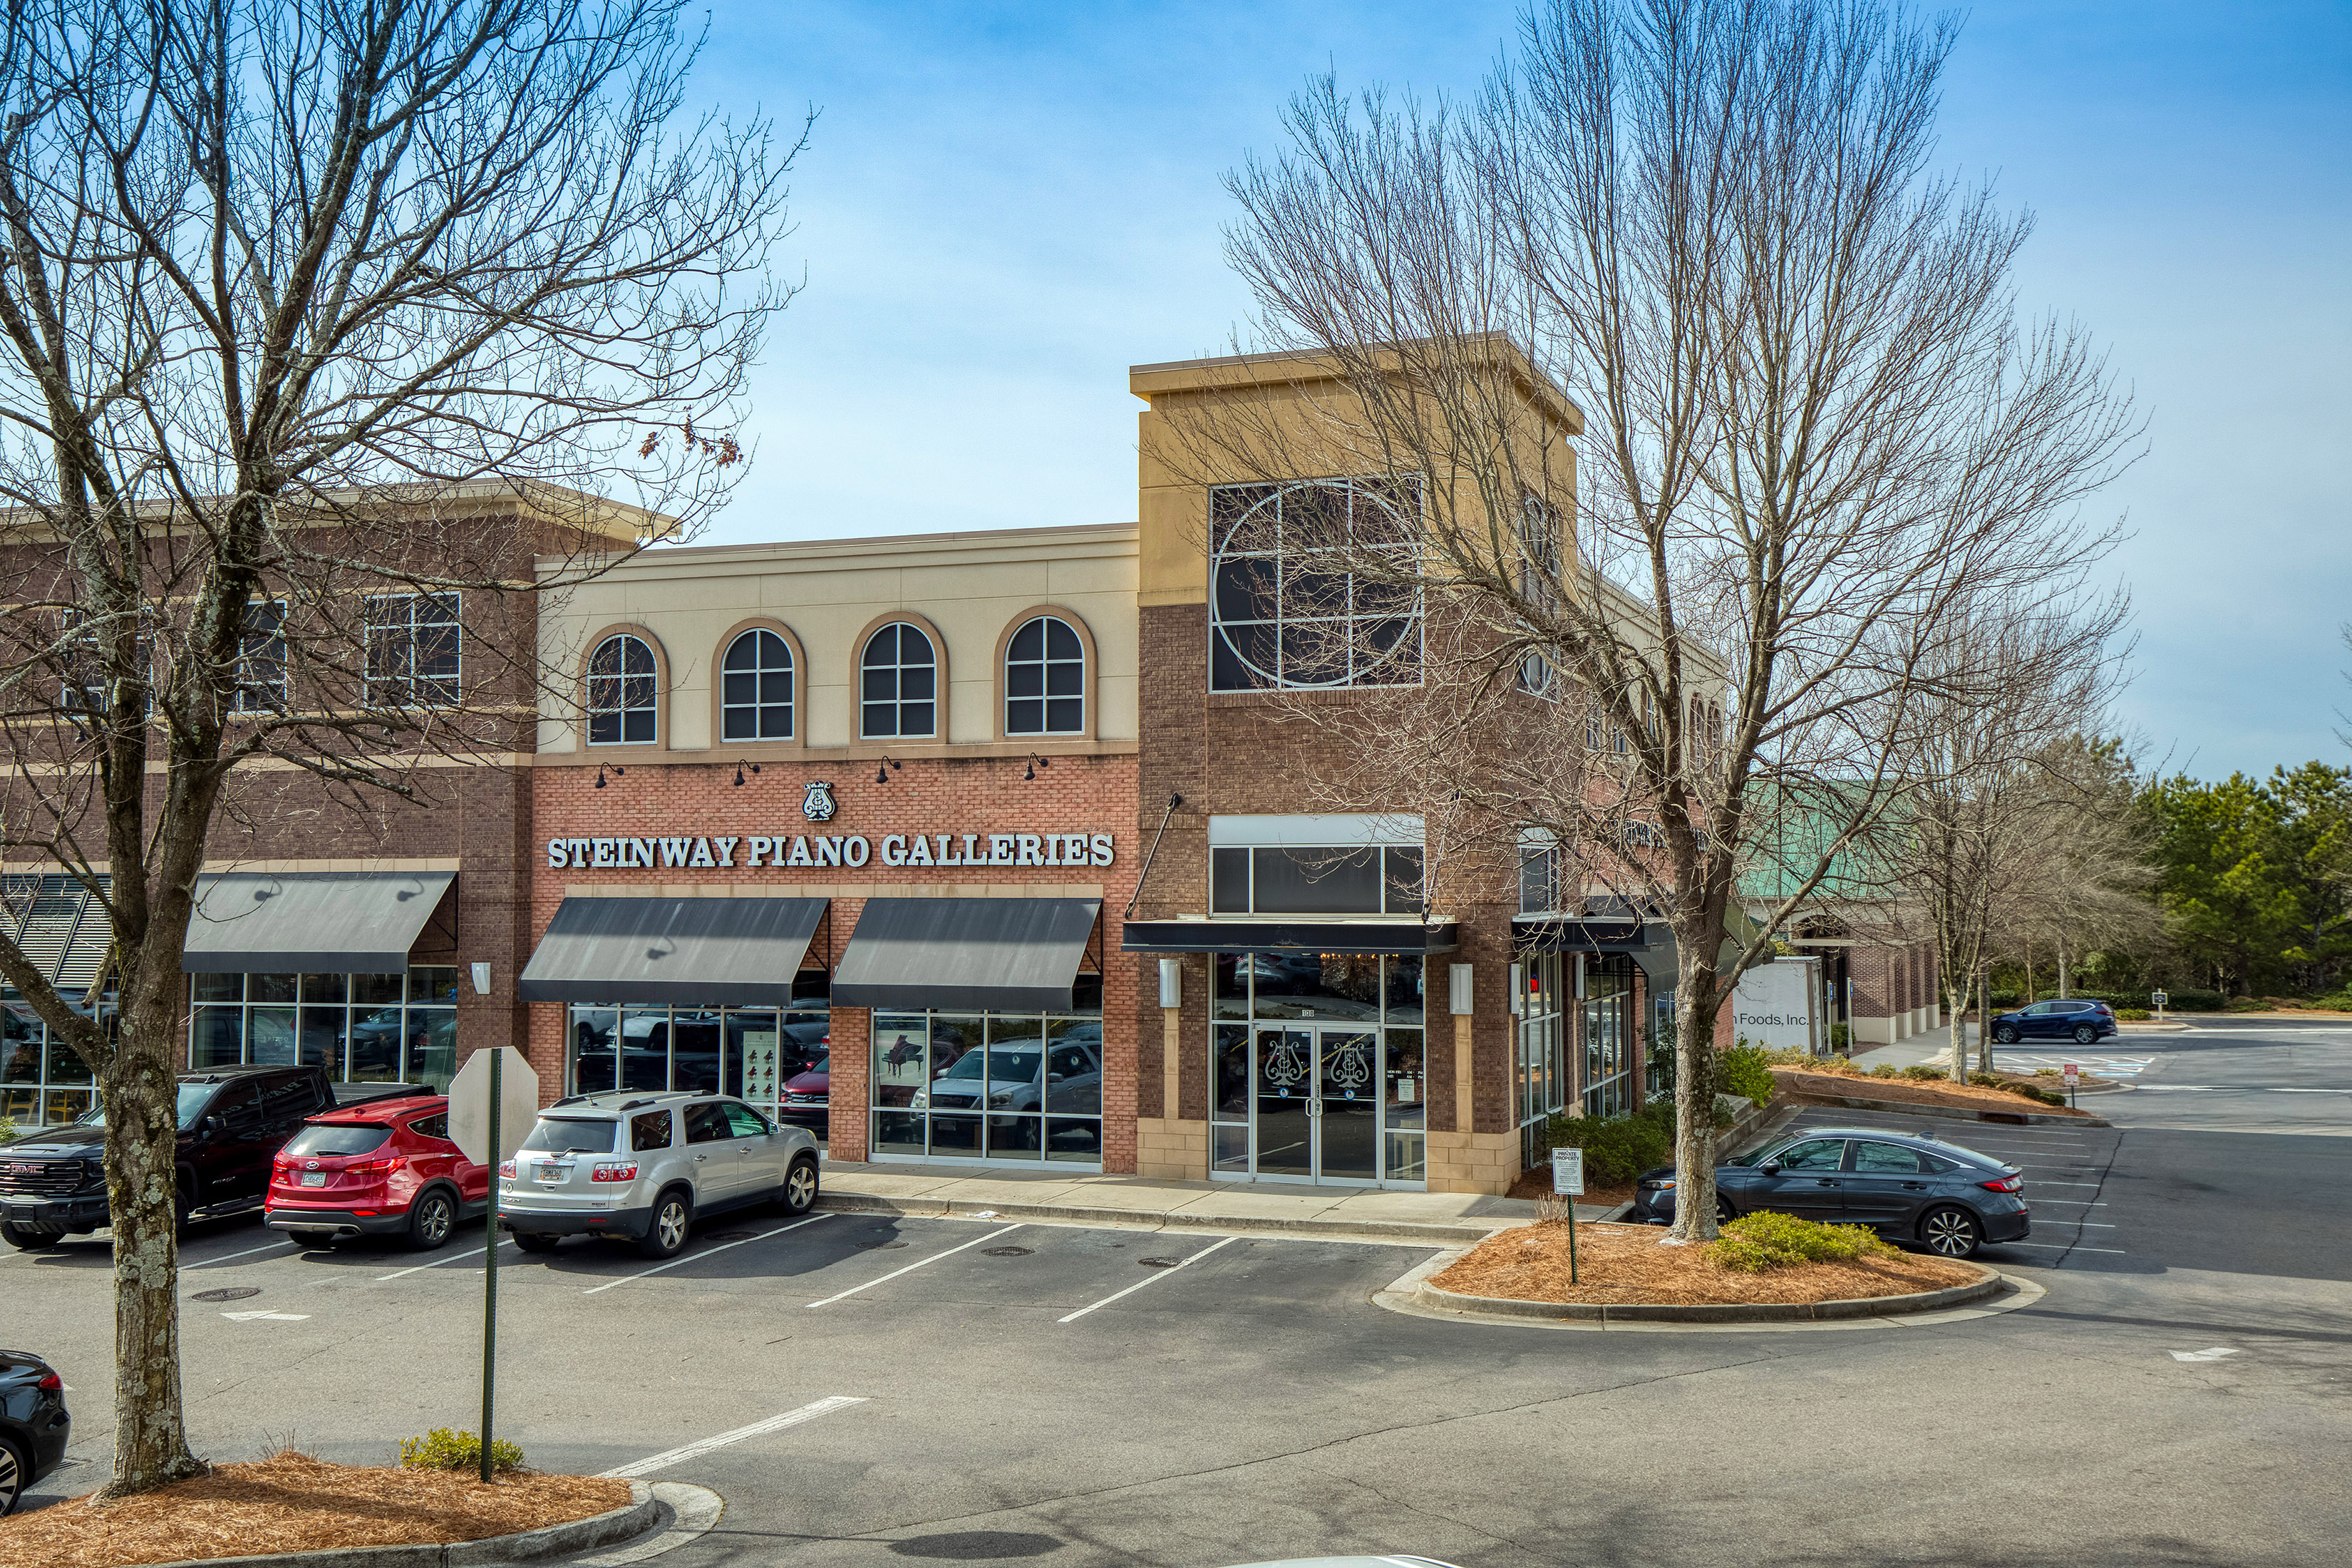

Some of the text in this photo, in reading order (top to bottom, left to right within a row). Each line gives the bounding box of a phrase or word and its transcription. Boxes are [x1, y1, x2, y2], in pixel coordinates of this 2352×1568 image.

[547, 833, 1115, 868] STEINWAY PIANO GALLERIES
[1740, 1013, 1784, 1027] Foods,
[1787, 1013, 1809, 1026] Inc.
[10, 1165, 44, 1174] GMC
